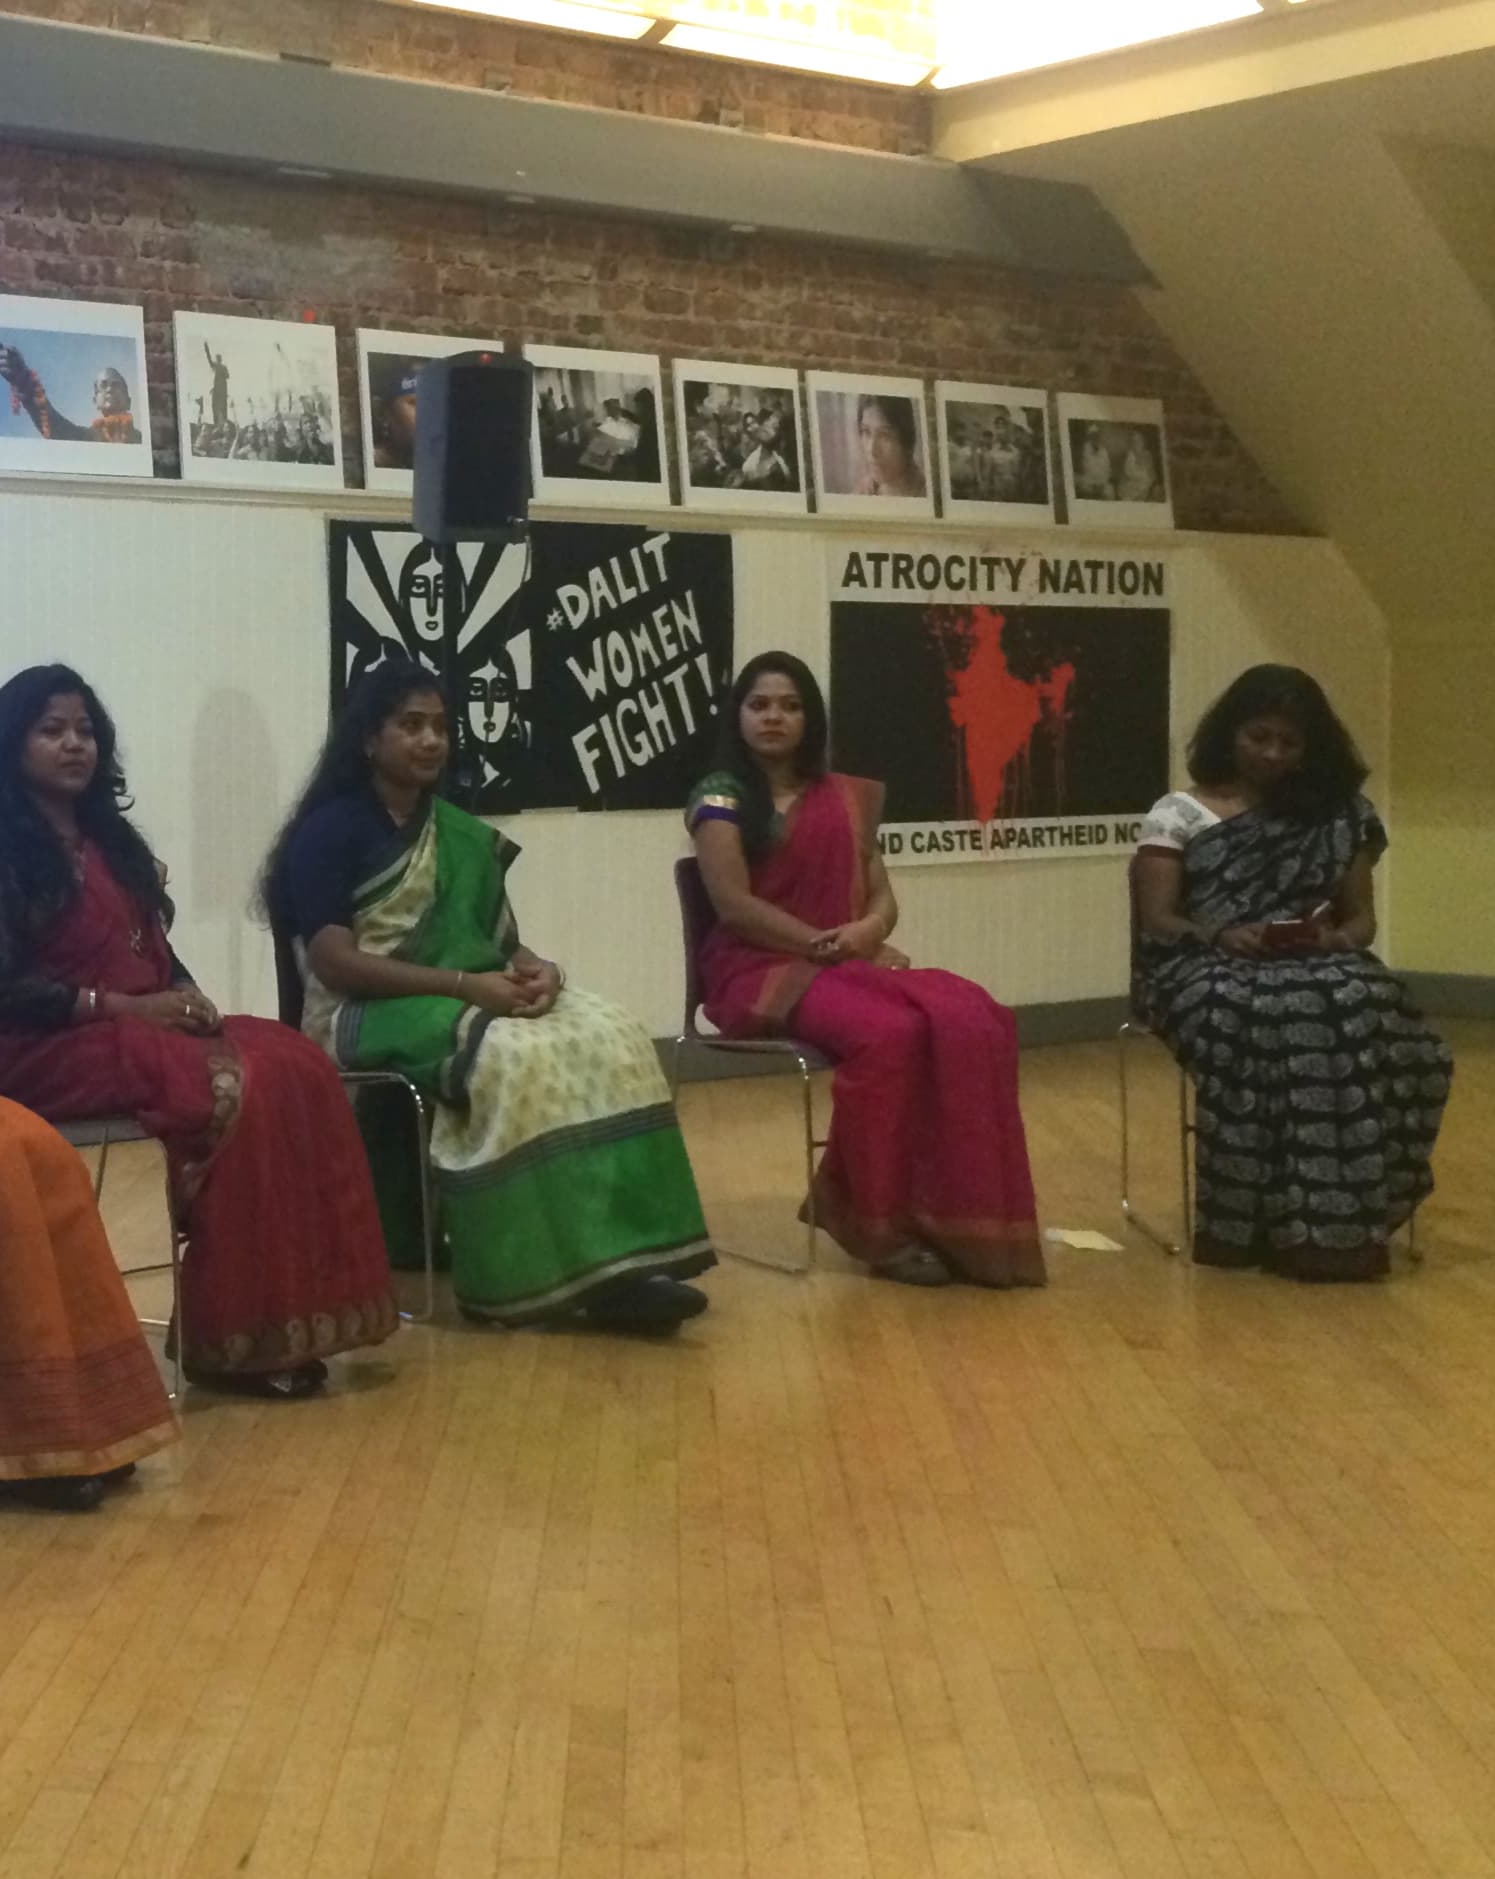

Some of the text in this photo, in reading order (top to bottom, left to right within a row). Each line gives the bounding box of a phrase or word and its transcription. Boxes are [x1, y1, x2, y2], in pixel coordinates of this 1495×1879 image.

[841, 551, 1165, 596] ATROCITY NATION
[565, 589, 703, 702] WOMEN
[571, 653, 718, 794] FIGHT!
[910, 829, 983, 854] CASTE
[990, 822, 1109, 849] APARTHEID
